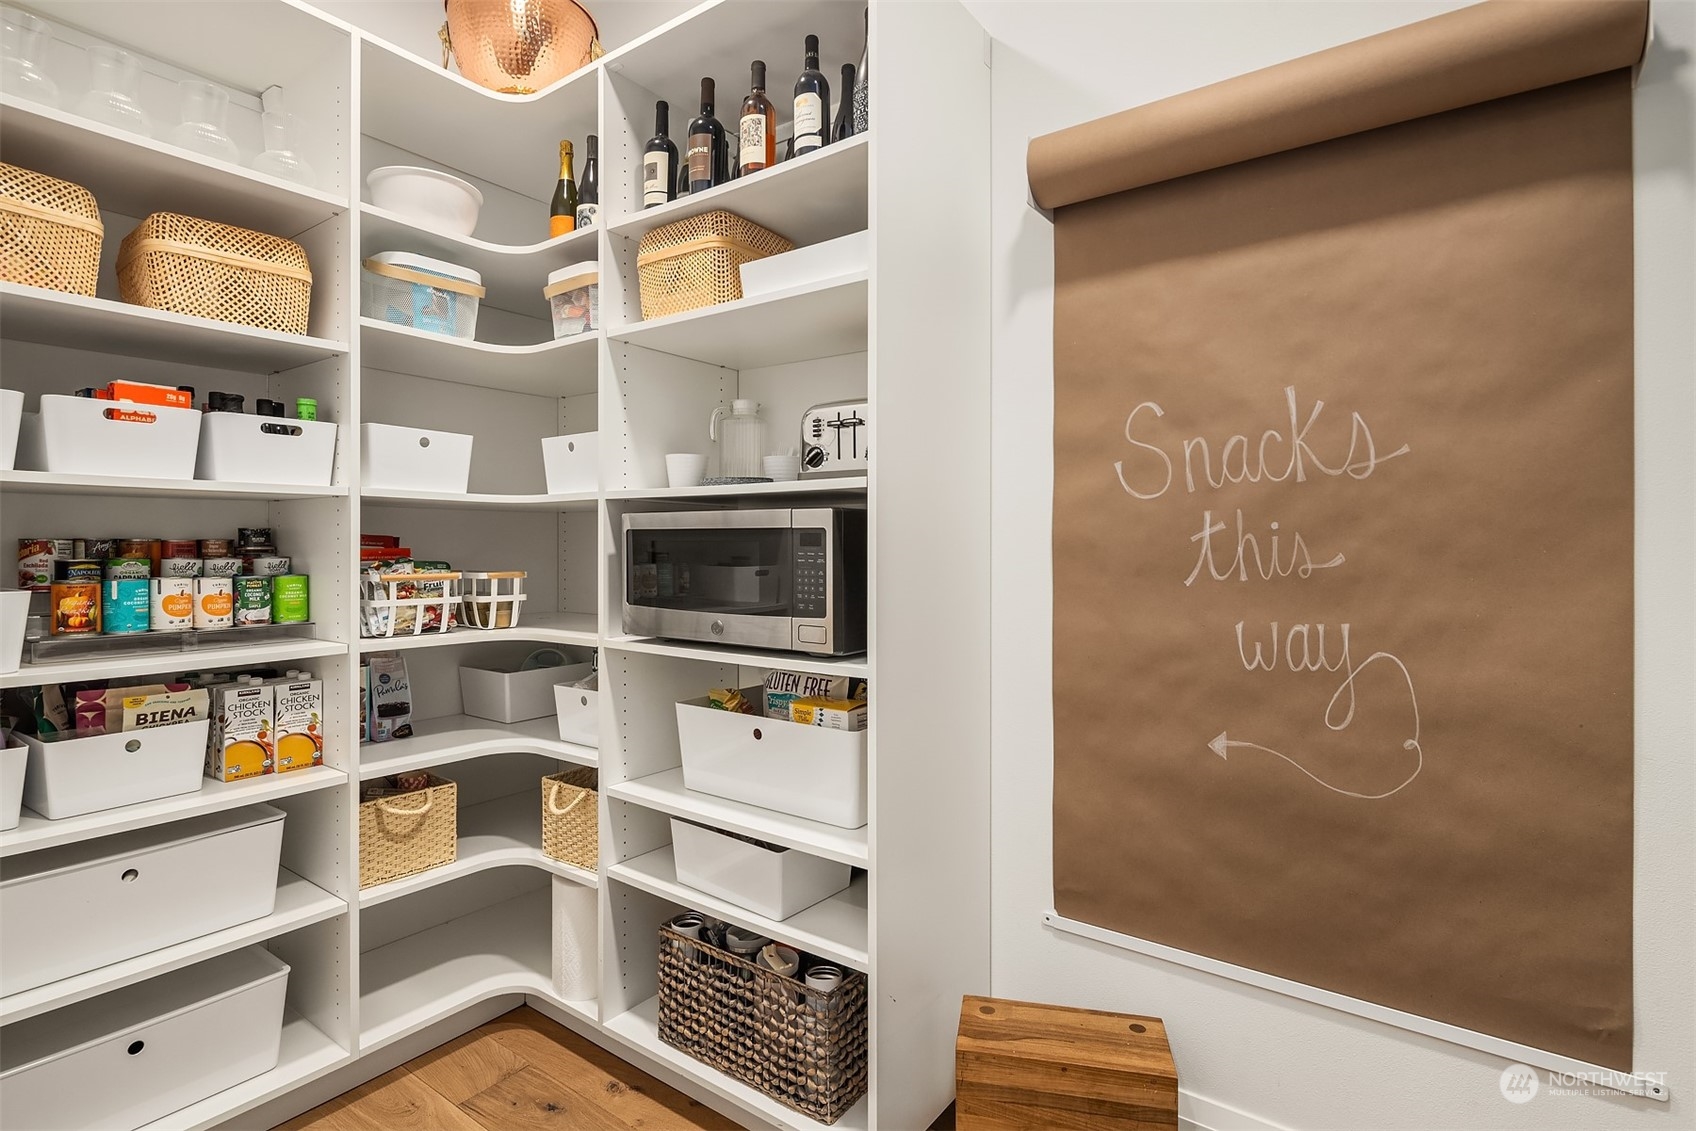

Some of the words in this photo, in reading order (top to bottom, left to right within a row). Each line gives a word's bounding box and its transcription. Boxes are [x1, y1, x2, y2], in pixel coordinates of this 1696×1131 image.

[1113, 384, 1411, 500] Snacks
[1183, 507, 1347, 587] this
[765, 671, 802, 693] GLUTEN
[1234, 619, 1357, 731] way
[803, 676, 833, 697] FREE
[227, 700, 271, 712] CHICKEN
[280, 694, 320, 706] CHICKEN
[284, 702, 316, 713] STOCK
[135, 706, 196, 726] BIENA
[233, 708, 266, 719] STOCK
